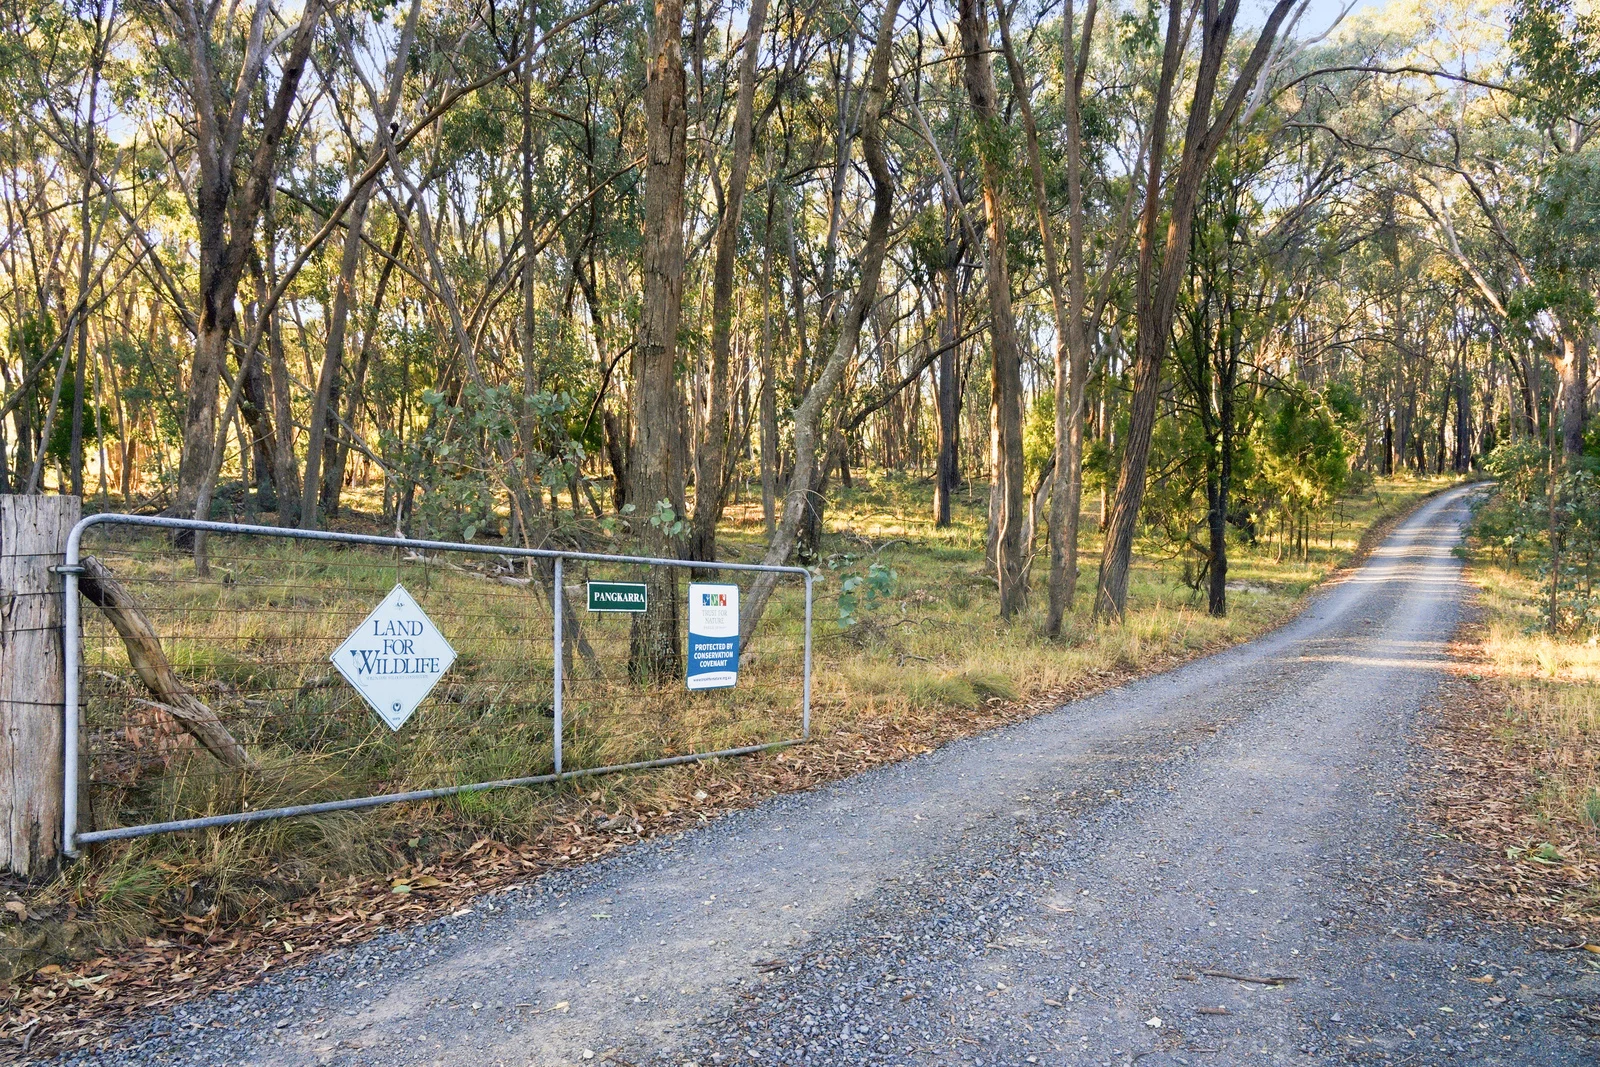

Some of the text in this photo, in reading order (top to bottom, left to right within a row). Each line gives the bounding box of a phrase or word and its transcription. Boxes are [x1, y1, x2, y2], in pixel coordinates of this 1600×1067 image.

[594, 592, 645, 603] PANGKARRA
[702, 609, 728, 617] TRUST FOR
[704, 617, 725, 625] NATURE
[373, 620, 424, 636] LAND
[383, 639, 415, 655] FOR
[694, 642, 734, 651] PROTECTED BY
[693, 651, 734, 660] CONSERVATION
[350, 650, 440, 675] WILDLIFE
[699, 660, 728, 668] COVENANT
